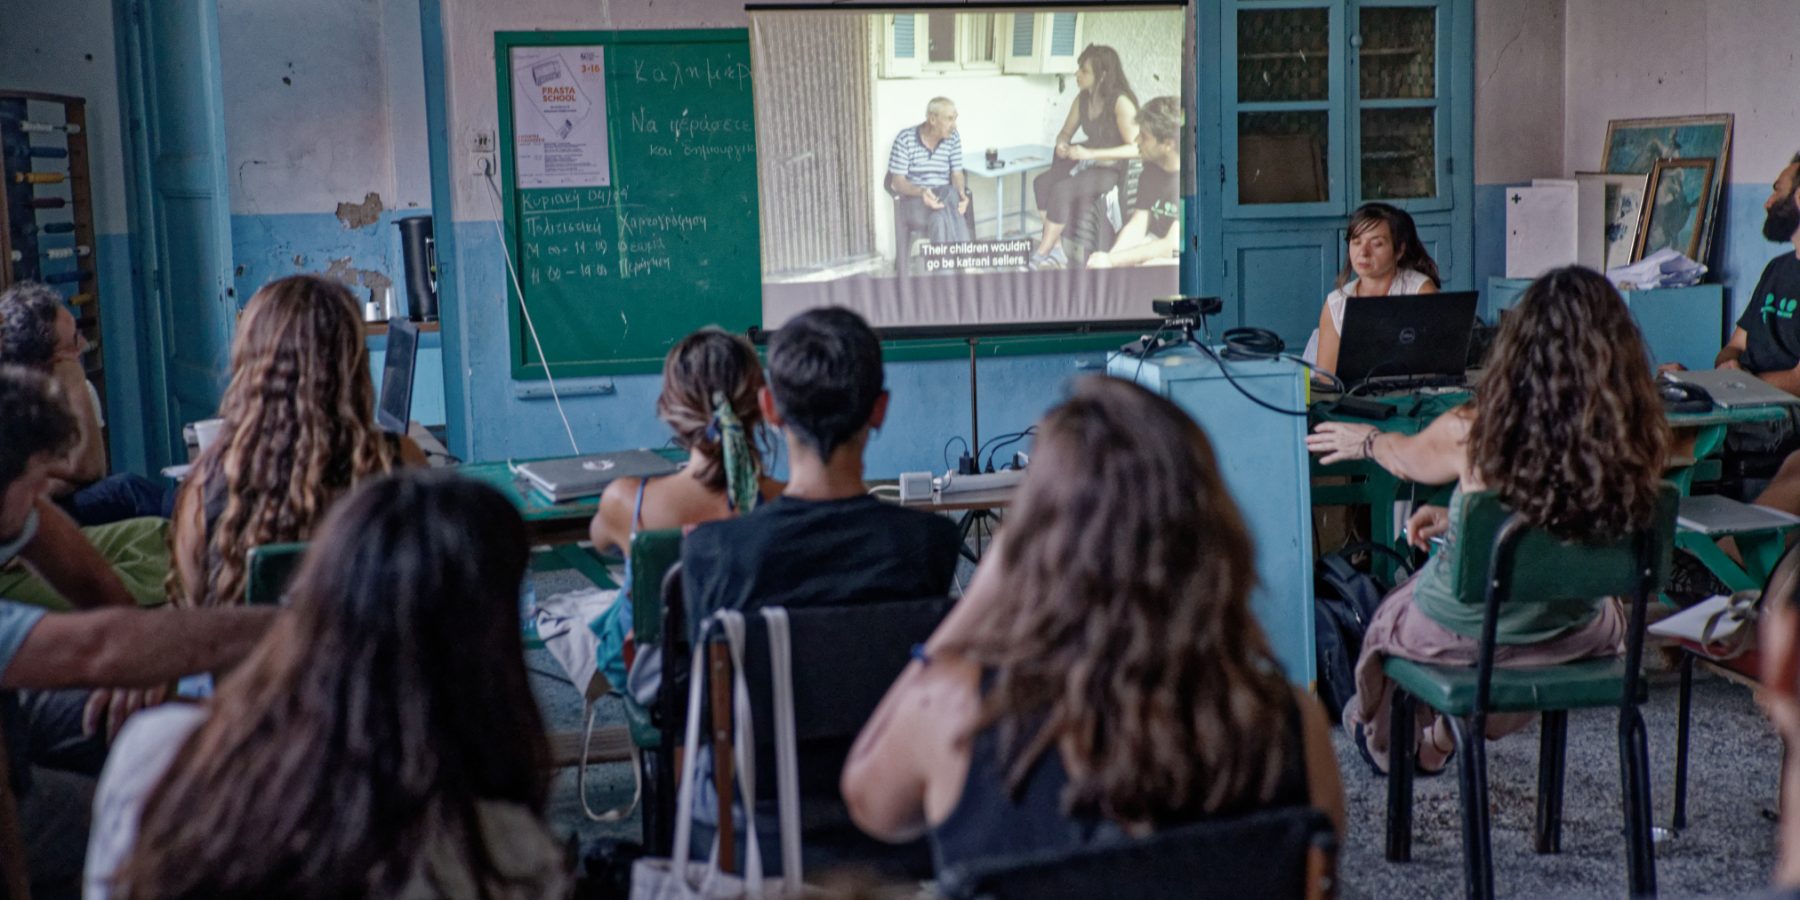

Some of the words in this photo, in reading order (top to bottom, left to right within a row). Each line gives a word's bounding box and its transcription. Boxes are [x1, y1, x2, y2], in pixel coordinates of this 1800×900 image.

[635, 53, 751, 91] Καλημέρ
[542, 86, 576, 95] FRASTA
[543, 95, 576, 103] SCHOOL
[631, 104, 658, 133] Να
[683, 142, 754, 162] δημιουργικ
[922, 244, 948, 255] Their
[949, 242, 989, 254] children
[991, 240, 1031, 252] wouldn't
[927, 261, 940, 271] go
[942, 258, 955, 268] be
[957, 256, 990, 267] katrani
[992, 254, 1027, 265] sellers.
